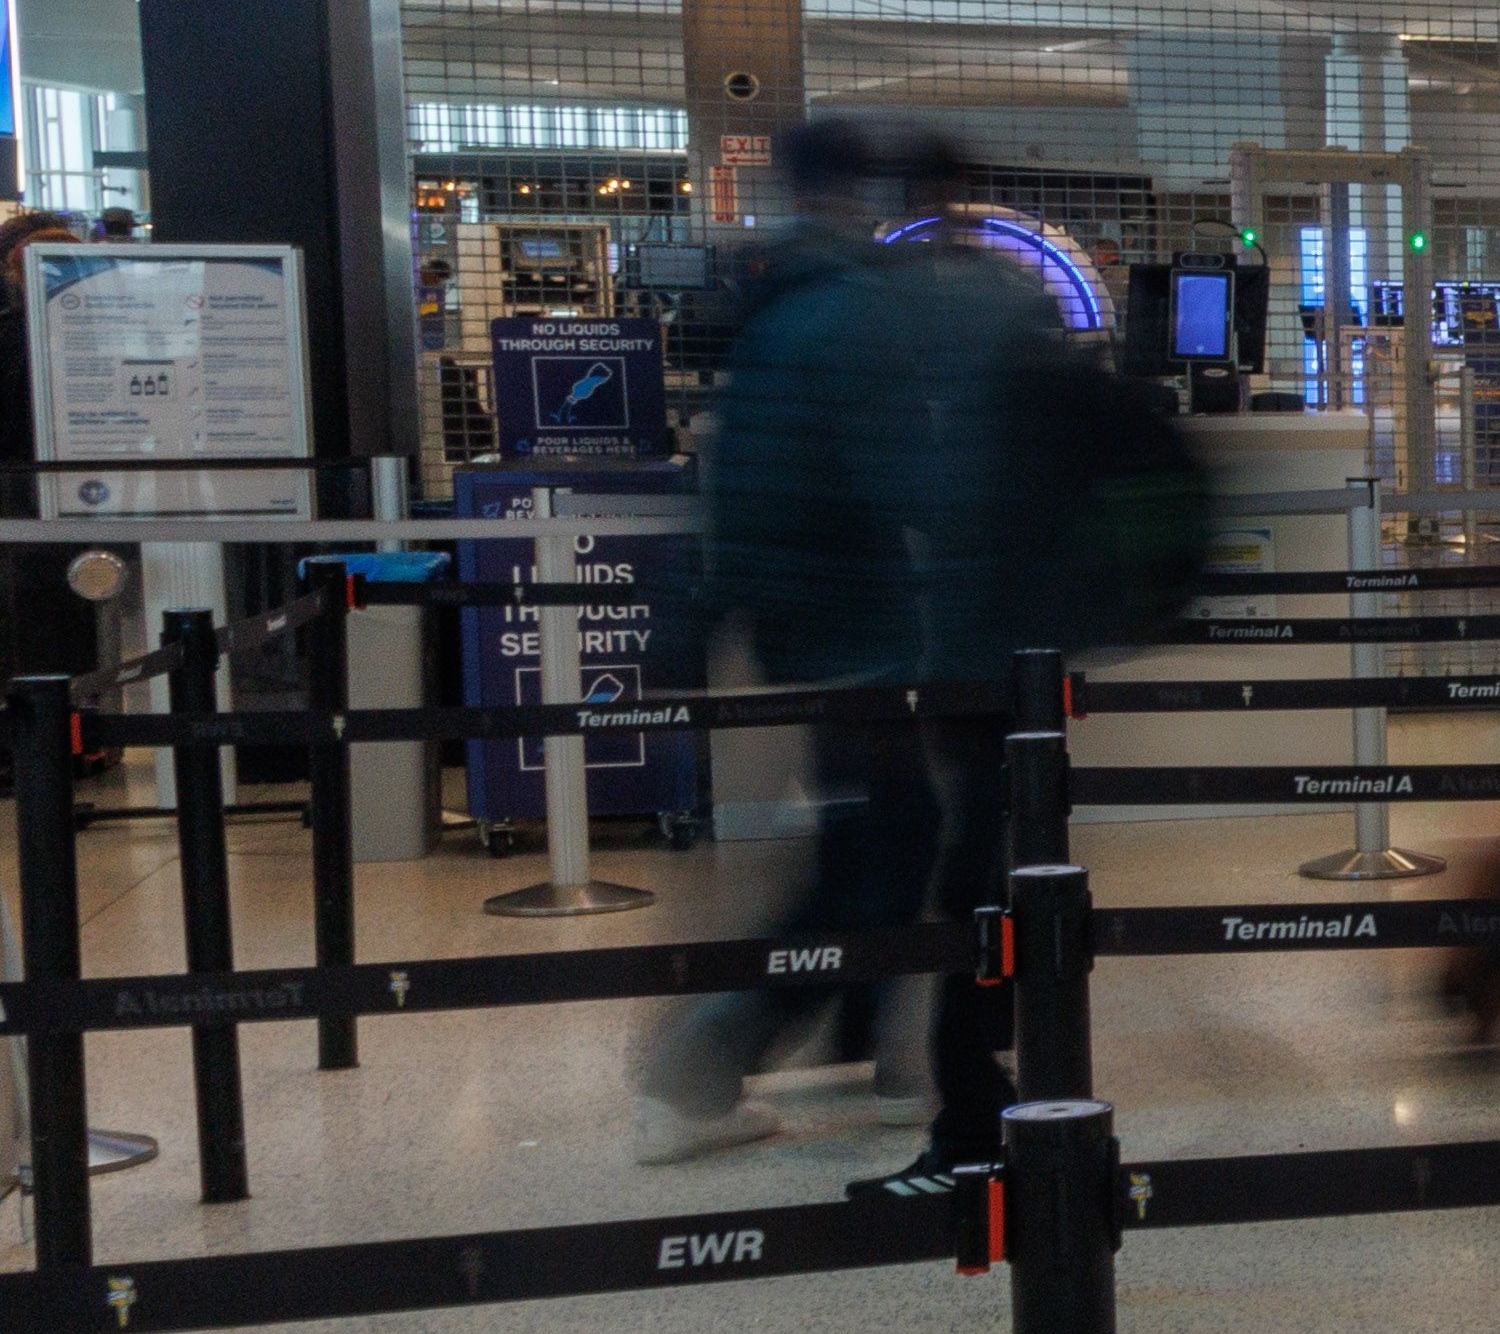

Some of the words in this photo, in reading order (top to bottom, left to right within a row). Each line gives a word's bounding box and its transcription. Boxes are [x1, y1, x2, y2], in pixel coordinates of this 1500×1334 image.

[532, 323, 556, 336] NO
[559, 323, 620, 336] LIQUIDS
[500, 338, 576, 352] THROUGH
[579, 338, 654, 352] SECURITY
[577, 707, 671, 727] Terminal
[673, 706, 690, 722] A
[1222, 915, 1352, 940] Terminal
[1355, 914, 1376, 936] A
[768, 947, 842, 973] EWR
[658, 1230, 764, 1268] EWR
